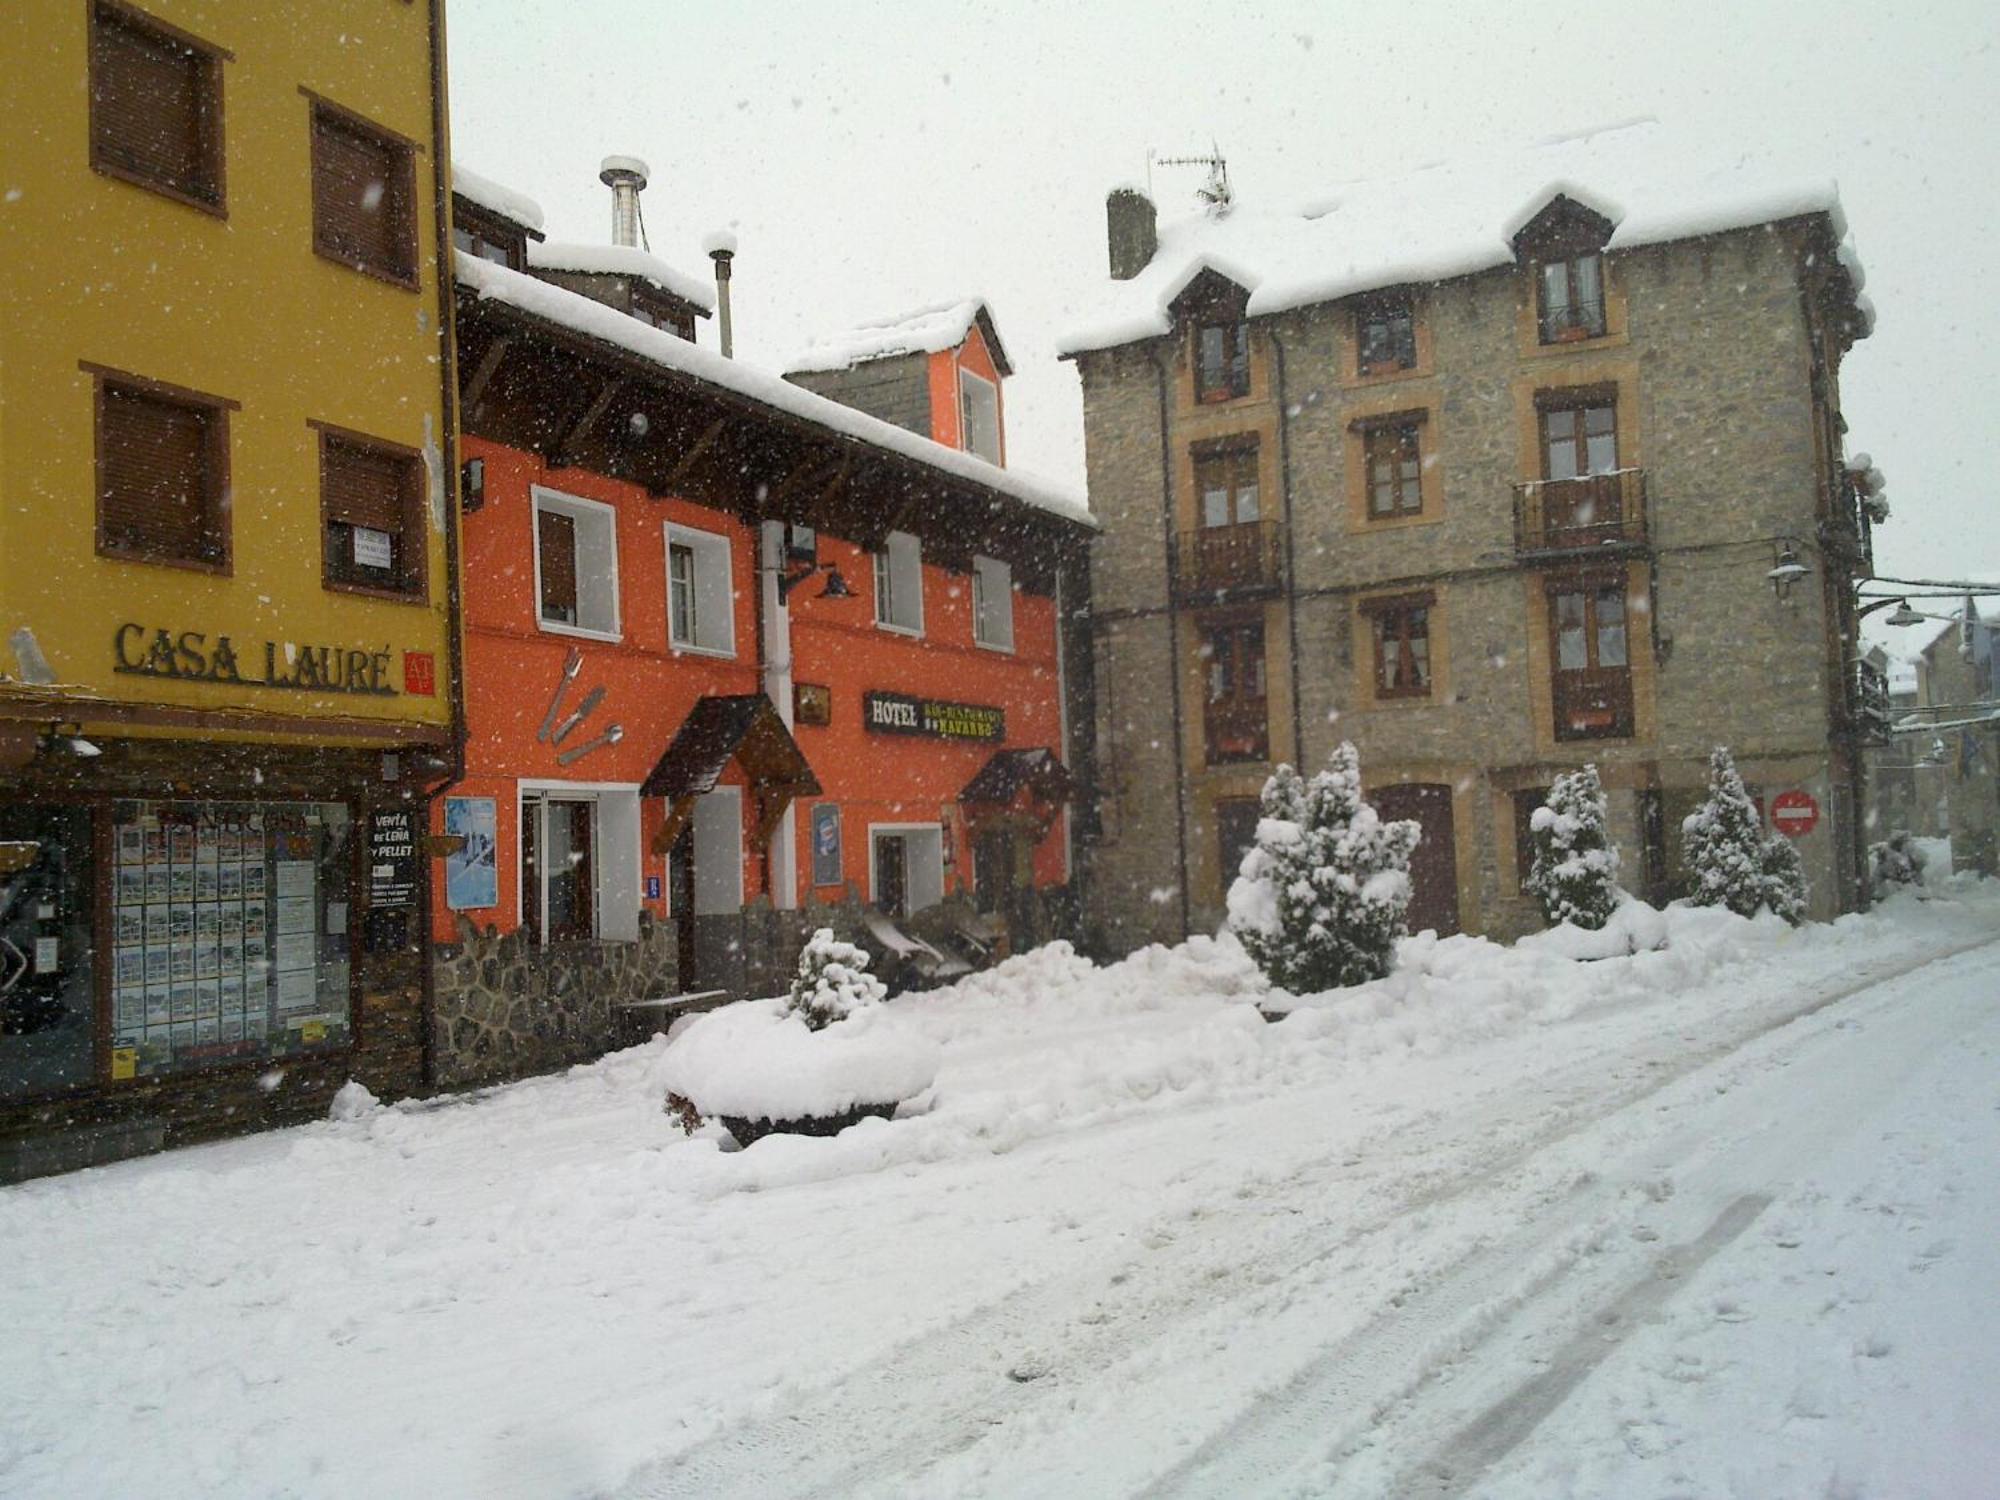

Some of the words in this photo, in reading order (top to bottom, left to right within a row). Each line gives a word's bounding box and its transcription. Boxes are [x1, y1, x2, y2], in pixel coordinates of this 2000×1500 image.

[114, 623, 240, 682] CASA
[265, 643, 397, 697] LAURÉ
[873, 700, 917, 727] HOTEL
[939, 718, 992, 737] NAVARRO
[375, 813, 408, 827] VENTA
[374, 833, 384, 842] DE
[385, 827, 410, 842] LEÑA
[379, 845, 413, 857] PELLET
